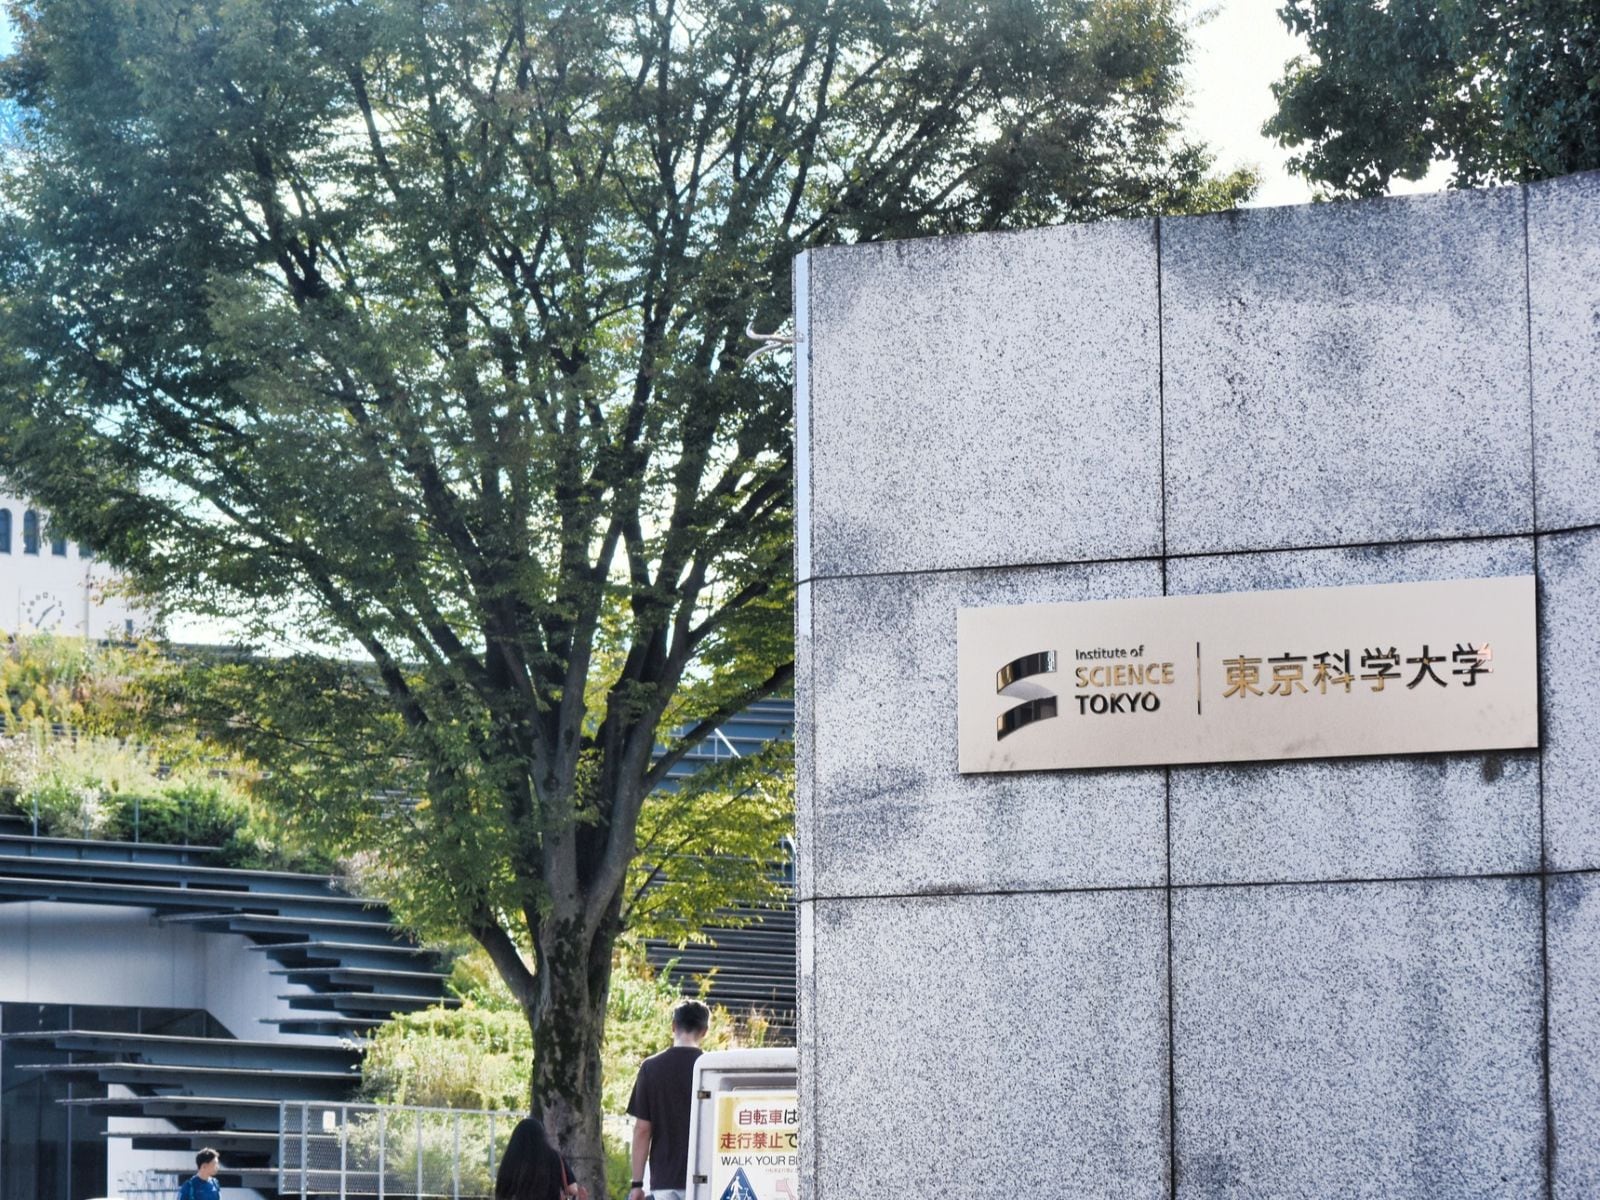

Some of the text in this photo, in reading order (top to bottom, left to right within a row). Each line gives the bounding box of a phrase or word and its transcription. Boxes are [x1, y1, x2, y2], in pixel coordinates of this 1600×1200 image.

[1075, 644, 1144, 660] Institute of
[1075, 662, 1175, 688] SCIENCE
[1222, 643, 1494, 698] 東京科学大学
[1075, 691, 1160, 715] TOKYO
[738, 1109, 798, 1125] 自転車は
[721, 1156, 752, 1166] WALK
[755, 1156, 785, 1166] YOUR
